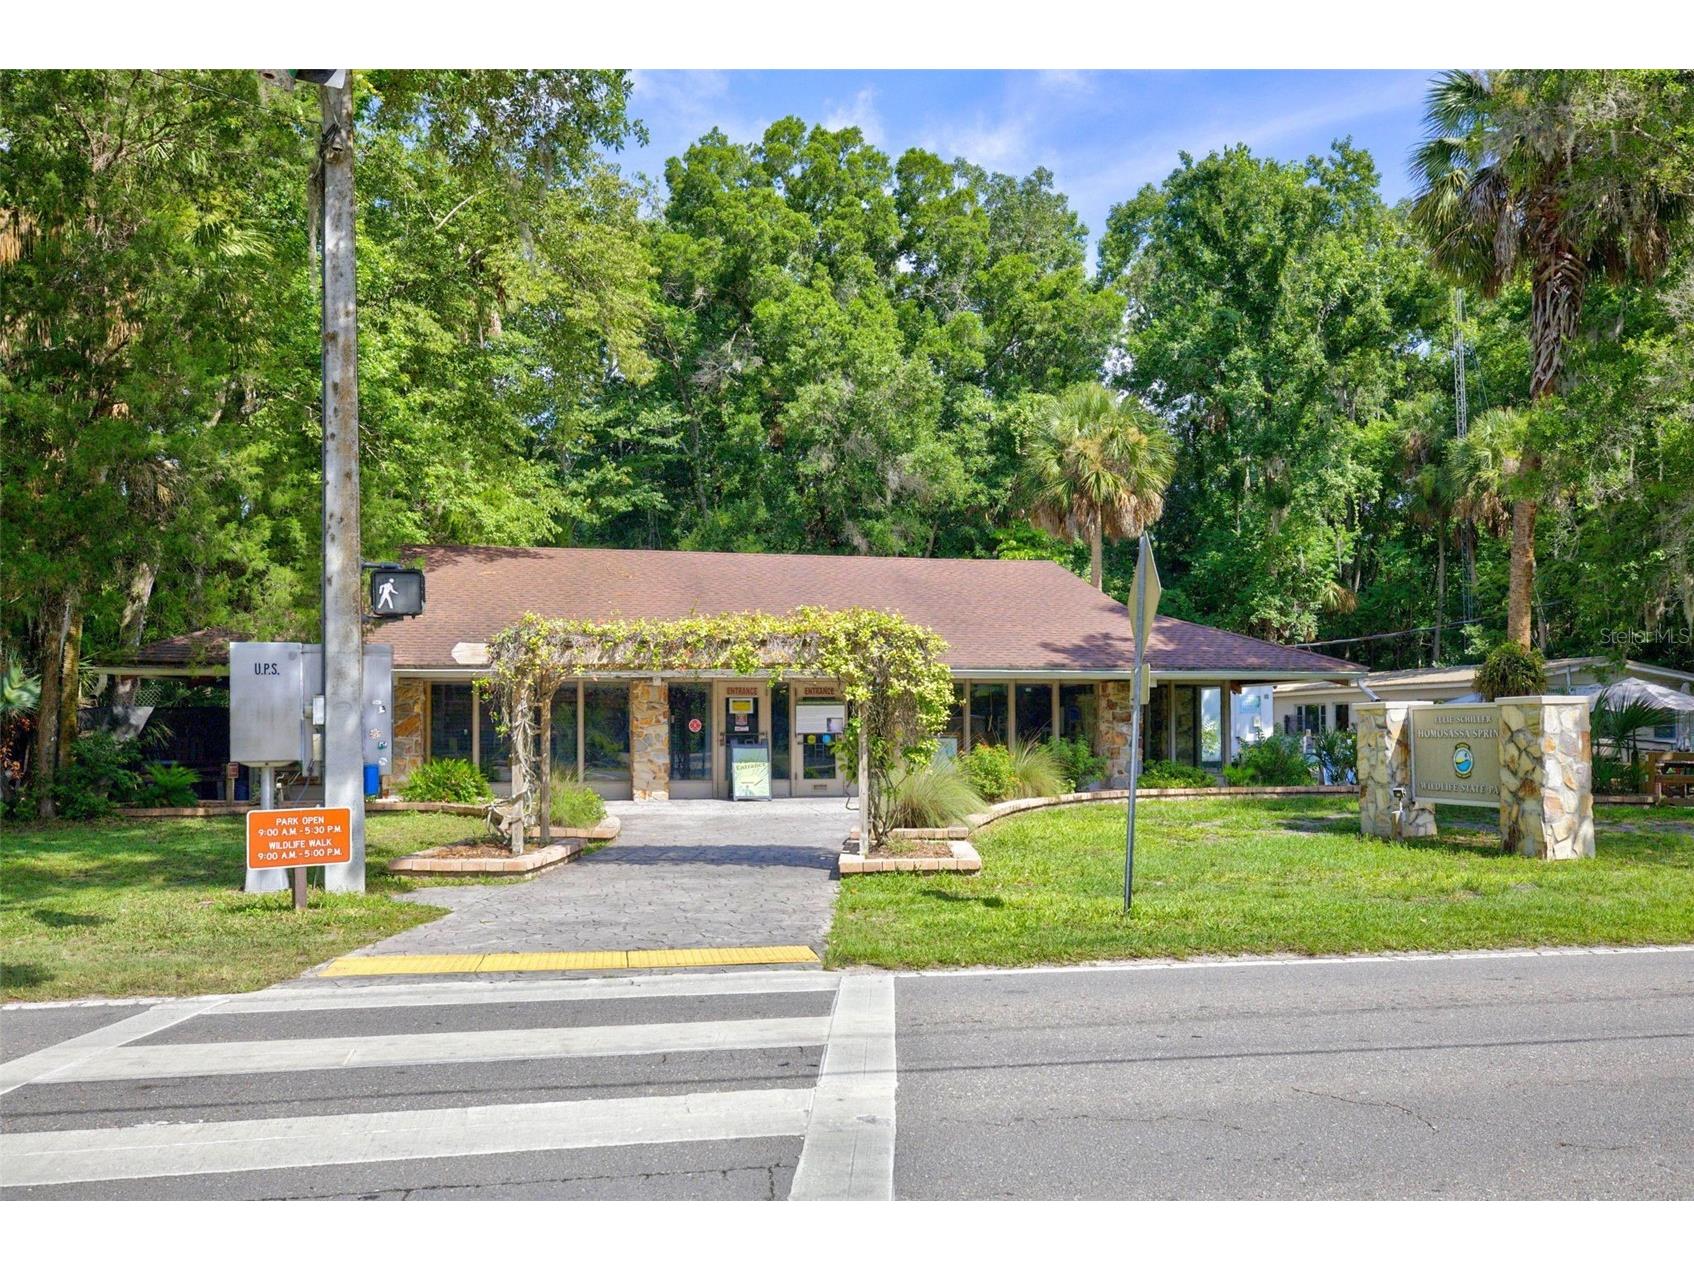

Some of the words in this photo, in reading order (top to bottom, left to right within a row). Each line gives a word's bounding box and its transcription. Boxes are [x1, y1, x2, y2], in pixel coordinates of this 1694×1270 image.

[254, 662, 280, 676] U.P.S.
[726, 687, 758, 696] ENTRANCE
[804, 687, 835, 696] ENTRANCE
[1417, 728, 1470, 738] HOMOSASSA
[1420, 782, 1459, 793] WILDLIFE
[1460, 783, 1486, 793] STATE
[275, 816, 299, 826] PARK
[302, 816, 325, 825] OPEN
[258, 828, 279, 837] 9:00
[304, 826, 325, 835] 5:30
[268, 840, 306, 850] WILDLIFE
[308, 838, 332, 847] WALK
[257, 851, 278, 861] 9:00
[304, 849, 325, 858] 5:00
